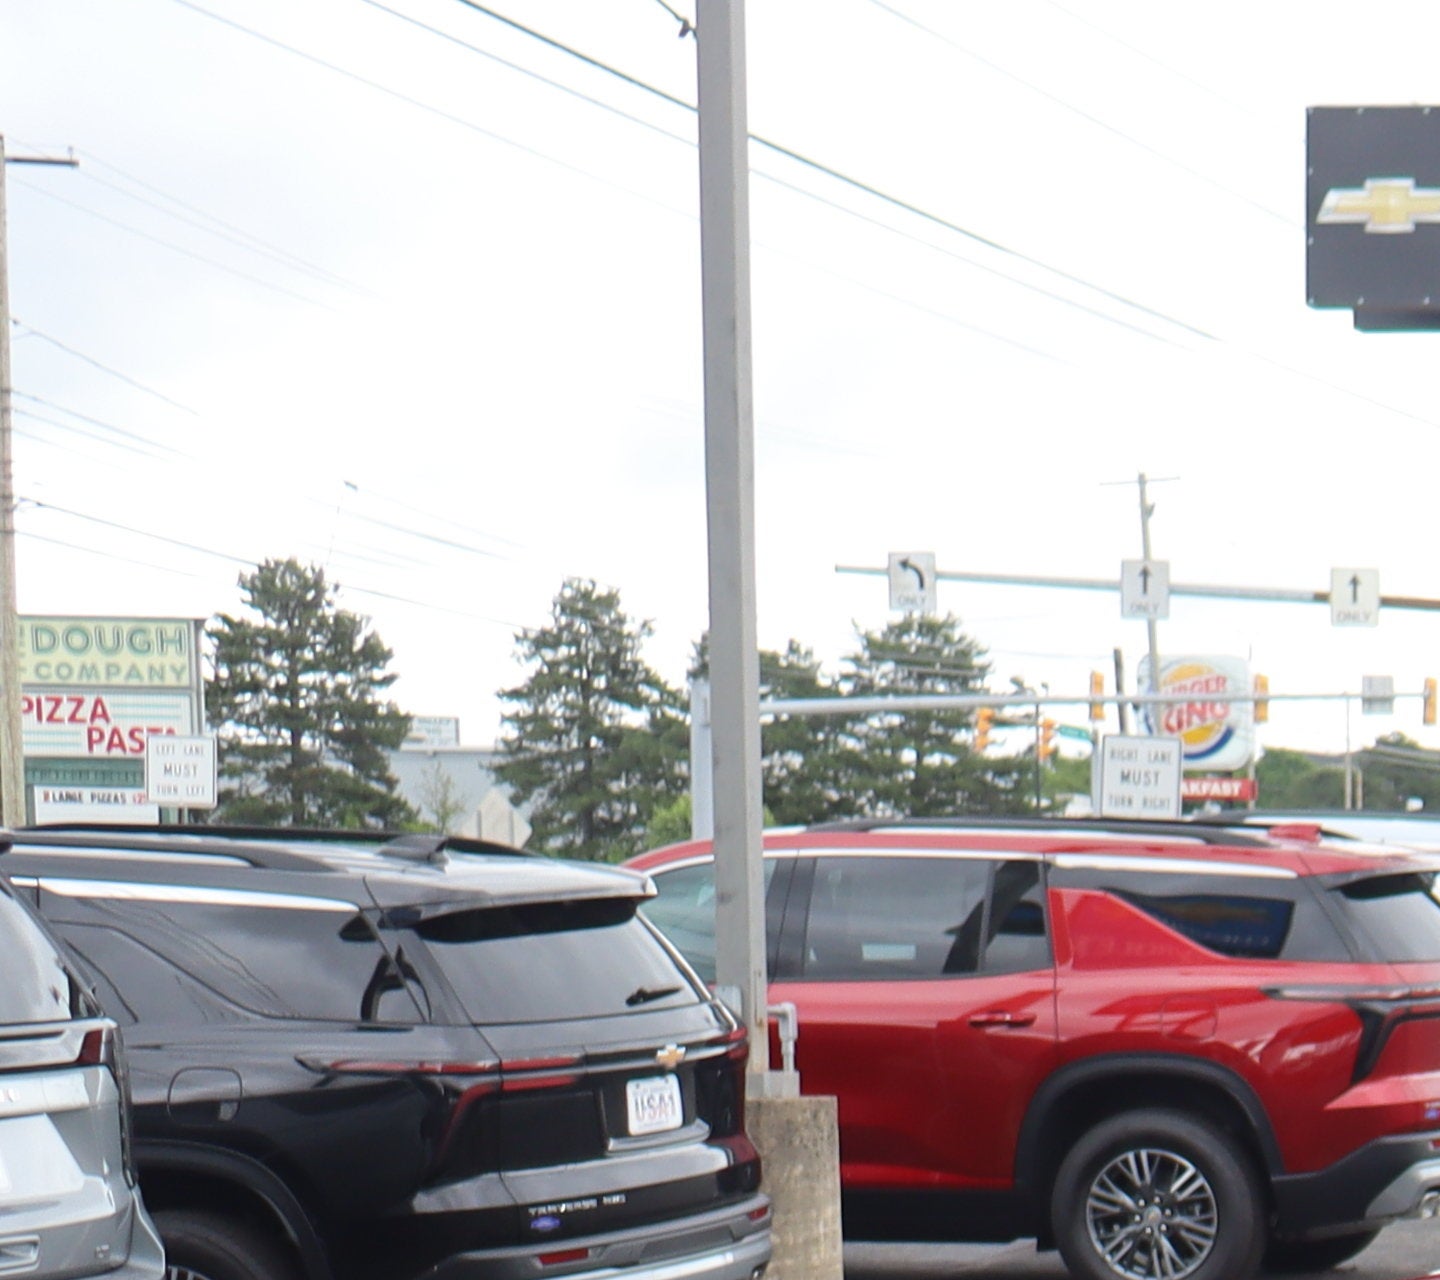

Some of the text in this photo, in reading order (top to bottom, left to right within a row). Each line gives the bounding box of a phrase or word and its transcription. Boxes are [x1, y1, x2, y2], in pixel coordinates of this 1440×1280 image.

[1337, 609, 1372, 623] ONLY
[31, 623, 187, 656] DOUGH
[34, 662, 188, 682] COMPANY
[86, 726, 177, 754] PAS
[163, 762, 199, 778] MUST
[1120, 769, 1161, 786] MUST
